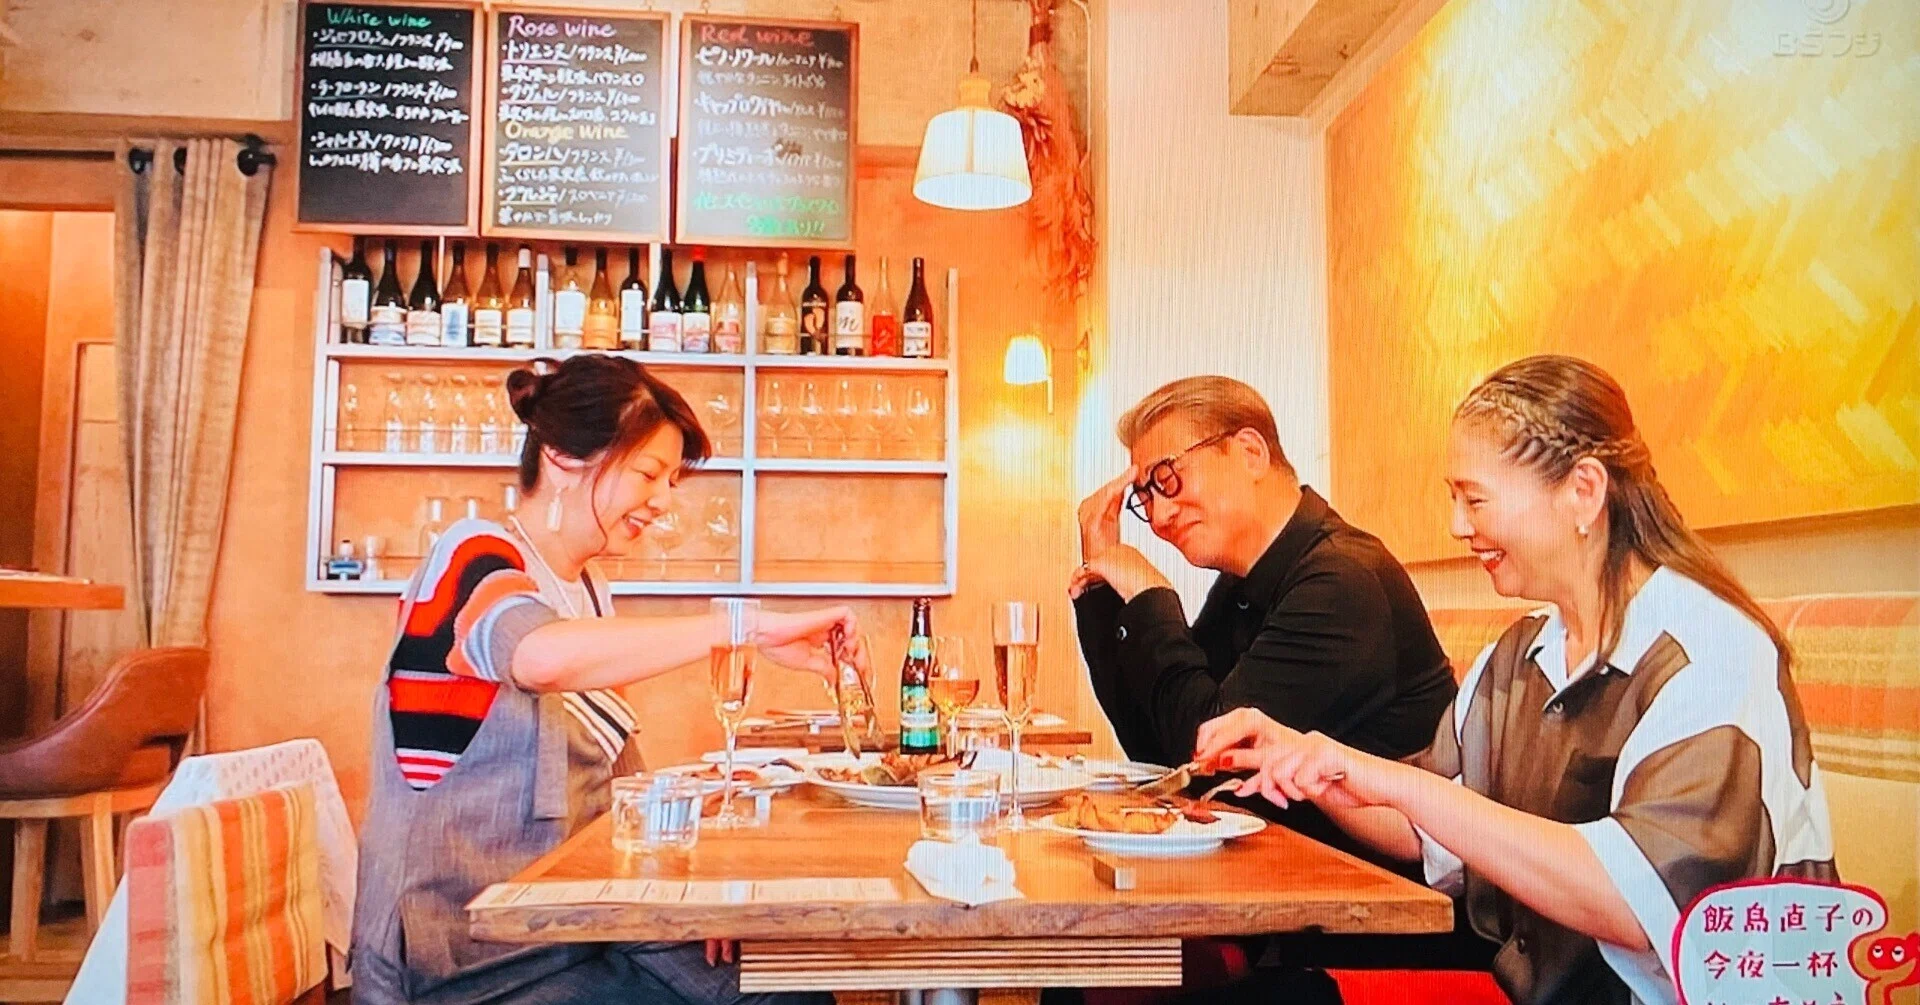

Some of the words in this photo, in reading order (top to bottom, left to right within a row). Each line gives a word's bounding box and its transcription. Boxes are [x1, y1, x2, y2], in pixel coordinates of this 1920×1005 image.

[326, 7, 382, 27] White
[388, 13, 432, 28] wine
[508, 15, 559, 38] Rose
[564, 19, 617, 38] wine
[701, 23, 750, 44] Red
[755, 26, 815, 47] wine
[504, 121, 575, 144] Orange
